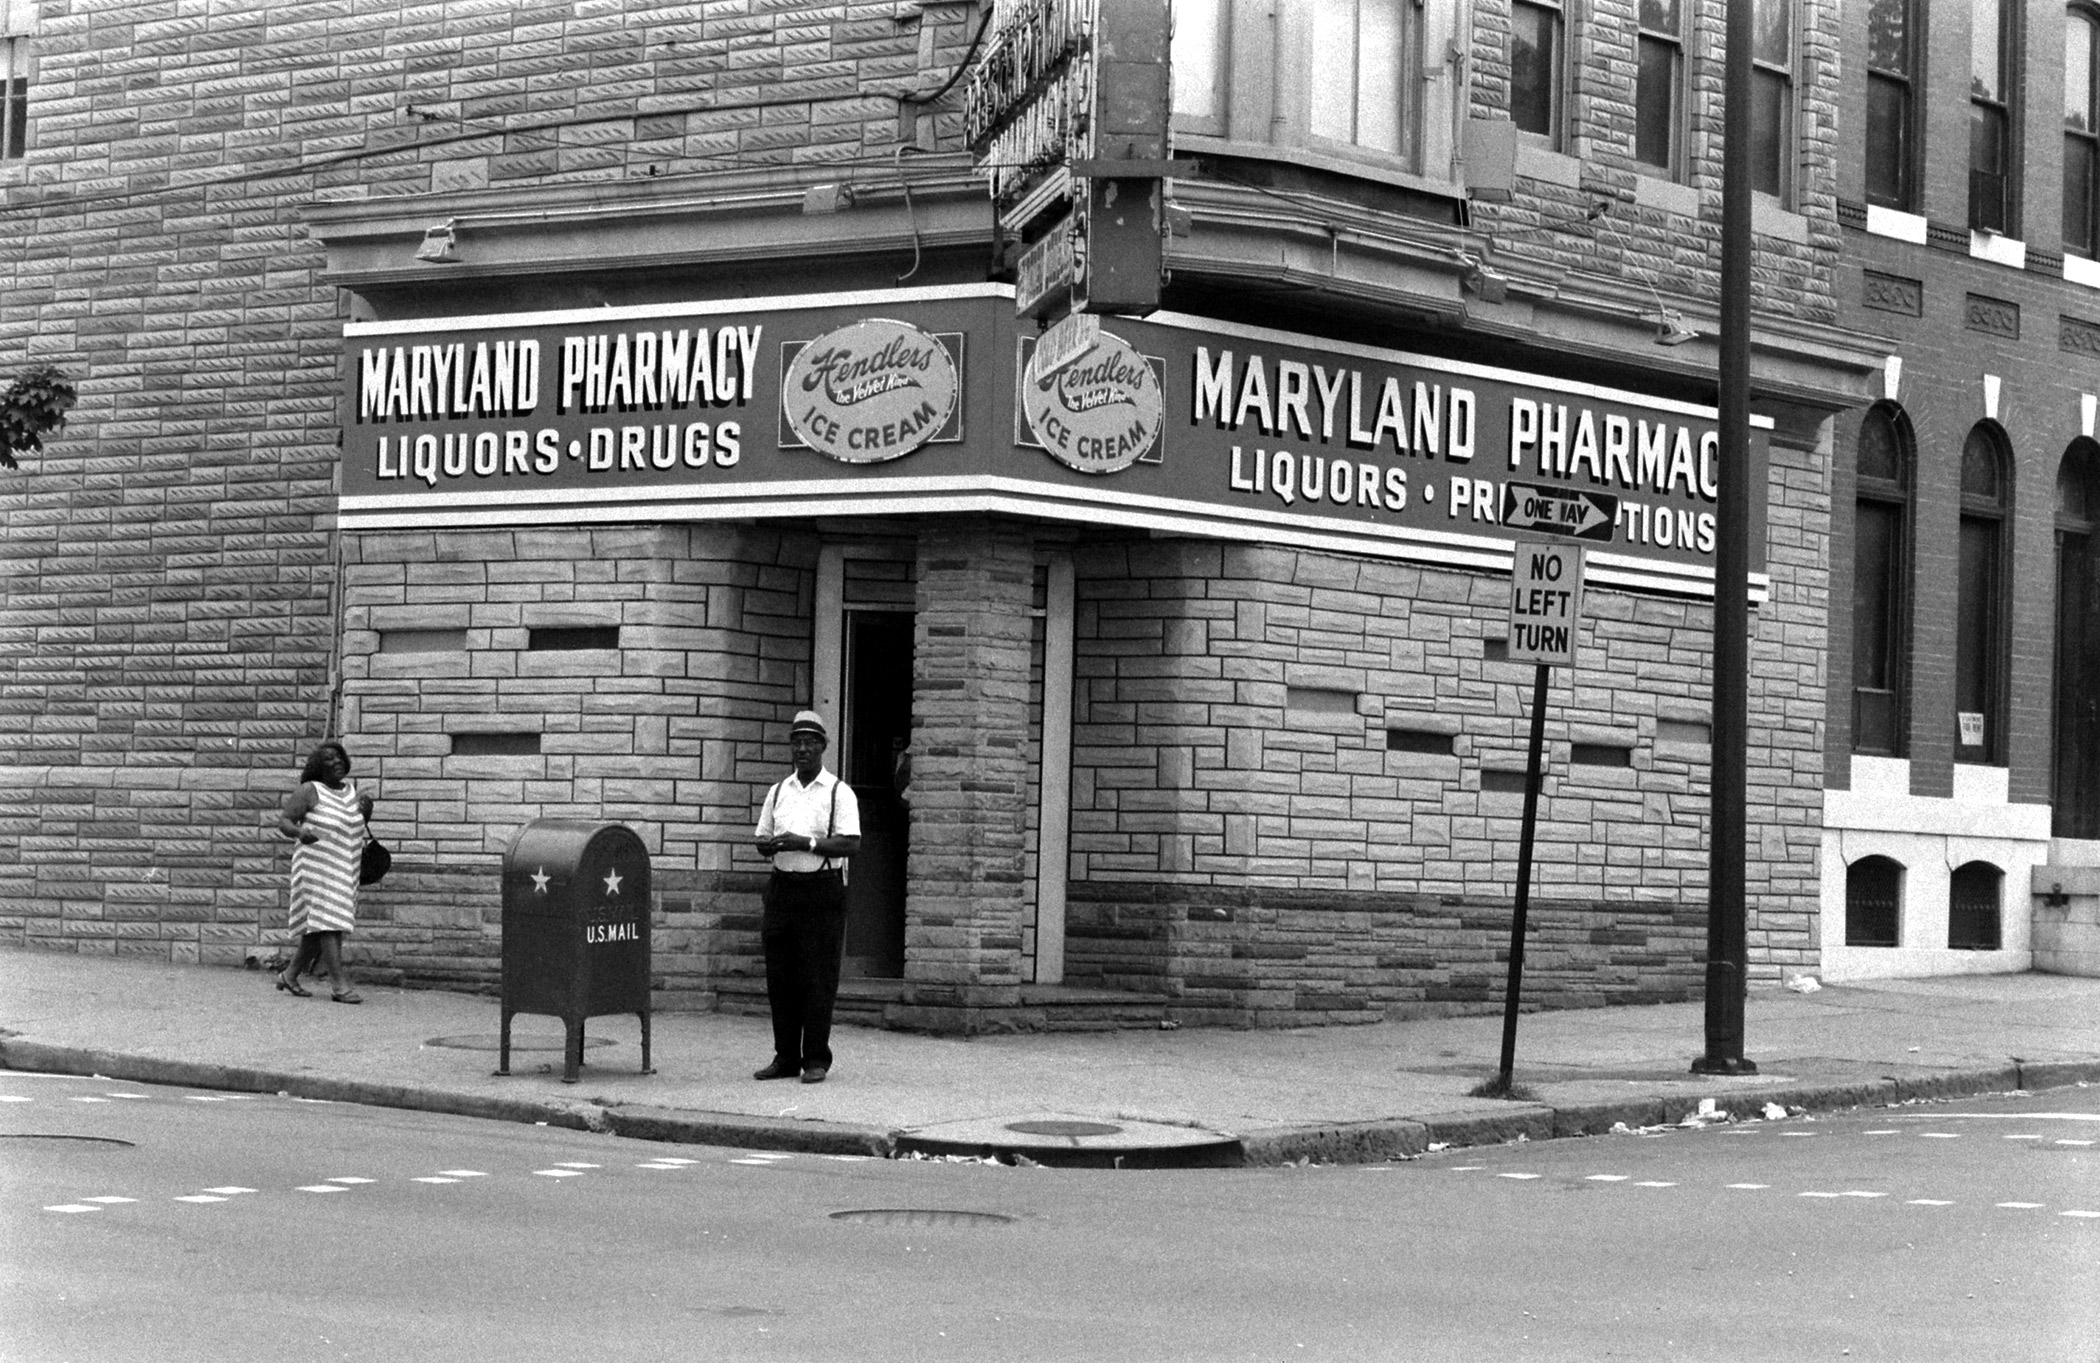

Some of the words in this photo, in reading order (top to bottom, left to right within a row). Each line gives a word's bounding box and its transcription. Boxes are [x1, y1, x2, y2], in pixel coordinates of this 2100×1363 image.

[360, 338, 541, 418] MARYLAND
[561, 324, 763, 409] PHARMACY
[801, 333, 934, 392] Hendlers
[832, 389, 851, 404] The
[852, 375, 886, 402] Velvet
[1081, 388, 1108, 410] Velvet
[802, 405, 841, 445] ICE
[847, 399, 938, 450] CREAM
[1039, 406, 1071, 450] ICE
[1077, 419, 1147, 460] CREAM
[1194, 345, 1476, 459] MARYLAND
[1511, 397, 1719, 499] PHARMAC
[377, 428, 560, 486] LIQUORS
[588, 420, 742, 470] DRUGS
[1230, 445, 1408, 511] LIQUORS
[1524, 497, 1554, 520] ONE
[1530, 553, 1562, 582] NO
[1514, 587, 1571, 617] LEFT
[1513, 622, 1569, 653] TURN
